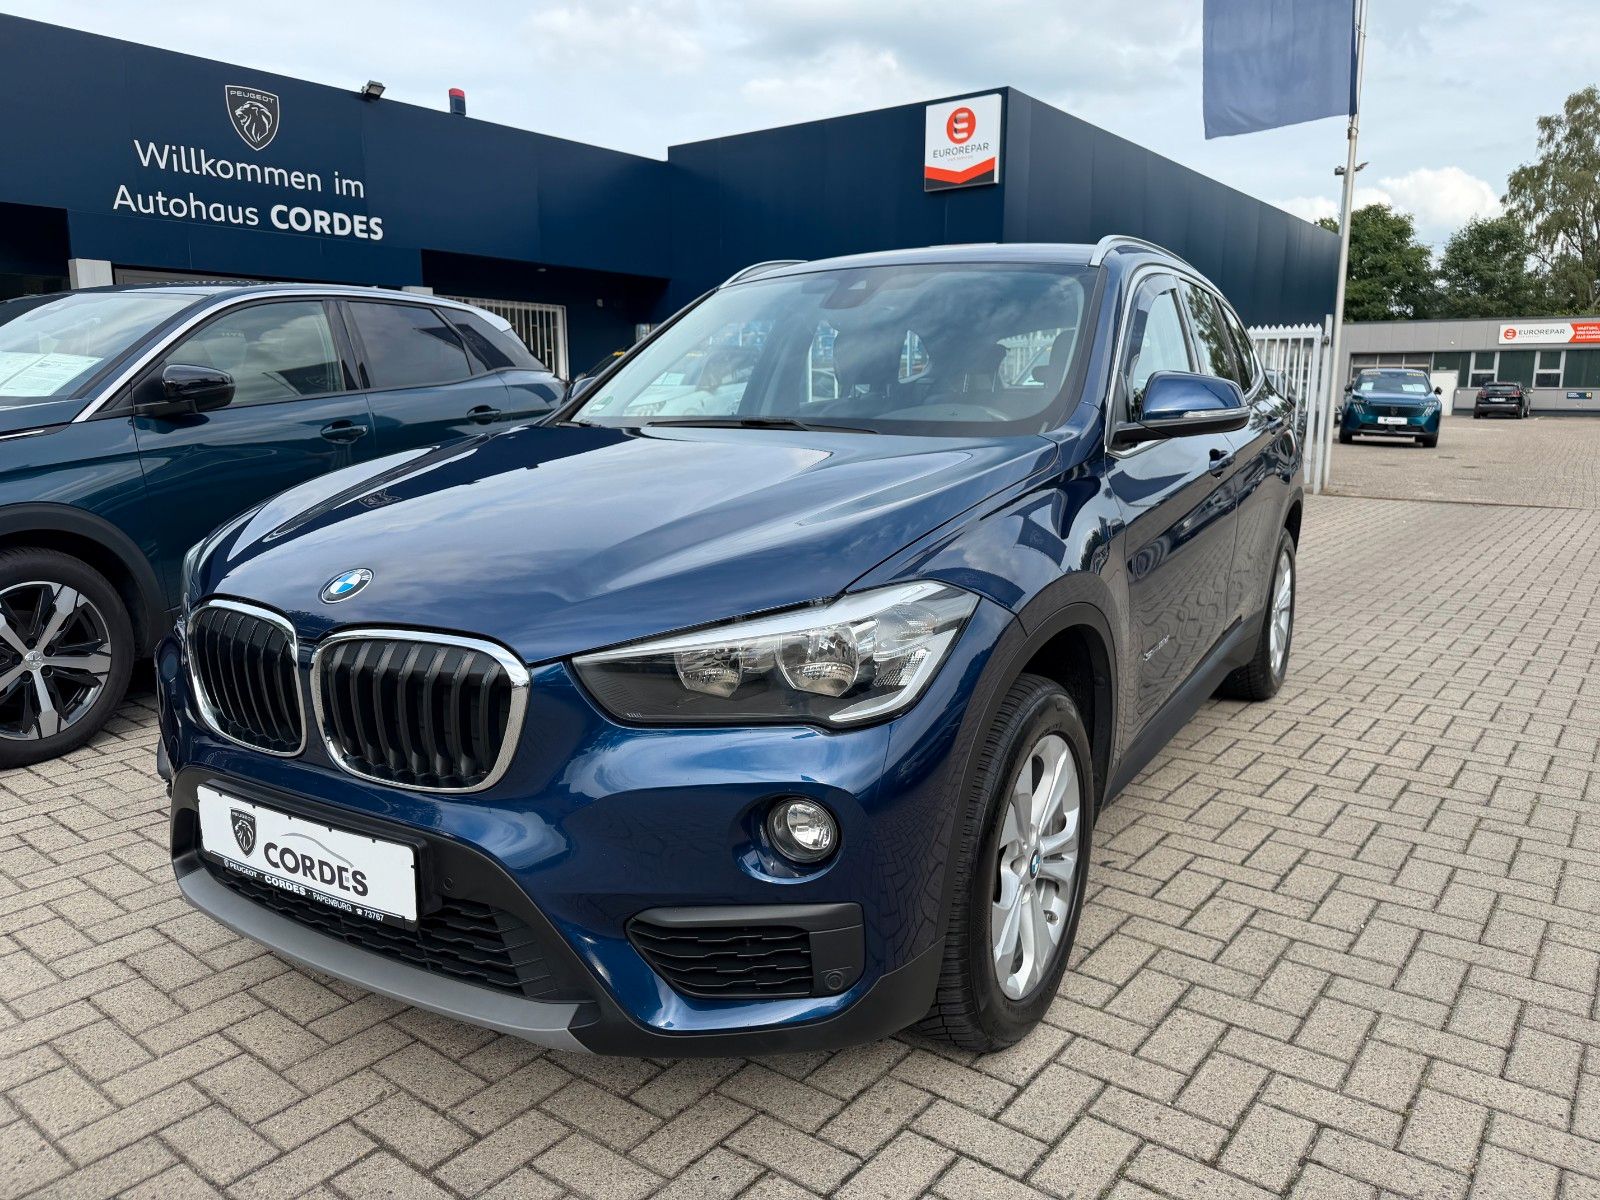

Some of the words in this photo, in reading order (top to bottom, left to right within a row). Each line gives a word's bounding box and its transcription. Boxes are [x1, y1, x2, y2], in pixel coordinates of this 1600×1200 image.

[230, 90, 275, 104] PEUGEOT
[133, 139, 322, 192] Willkommen
[334, 171, 365, 198] im
[933, 142, 989, 158] EUROREPAR
[112, 184, 259, 226] Autohaus
[270, 204, 384, 241] CORDES
[230, 862, 257, 877] PEUGEOT
[265, 875, 306, 895] CORDES
[312, 892, 352, 912] PAPENBURG
[263, 842, 369, 897] CORDES
